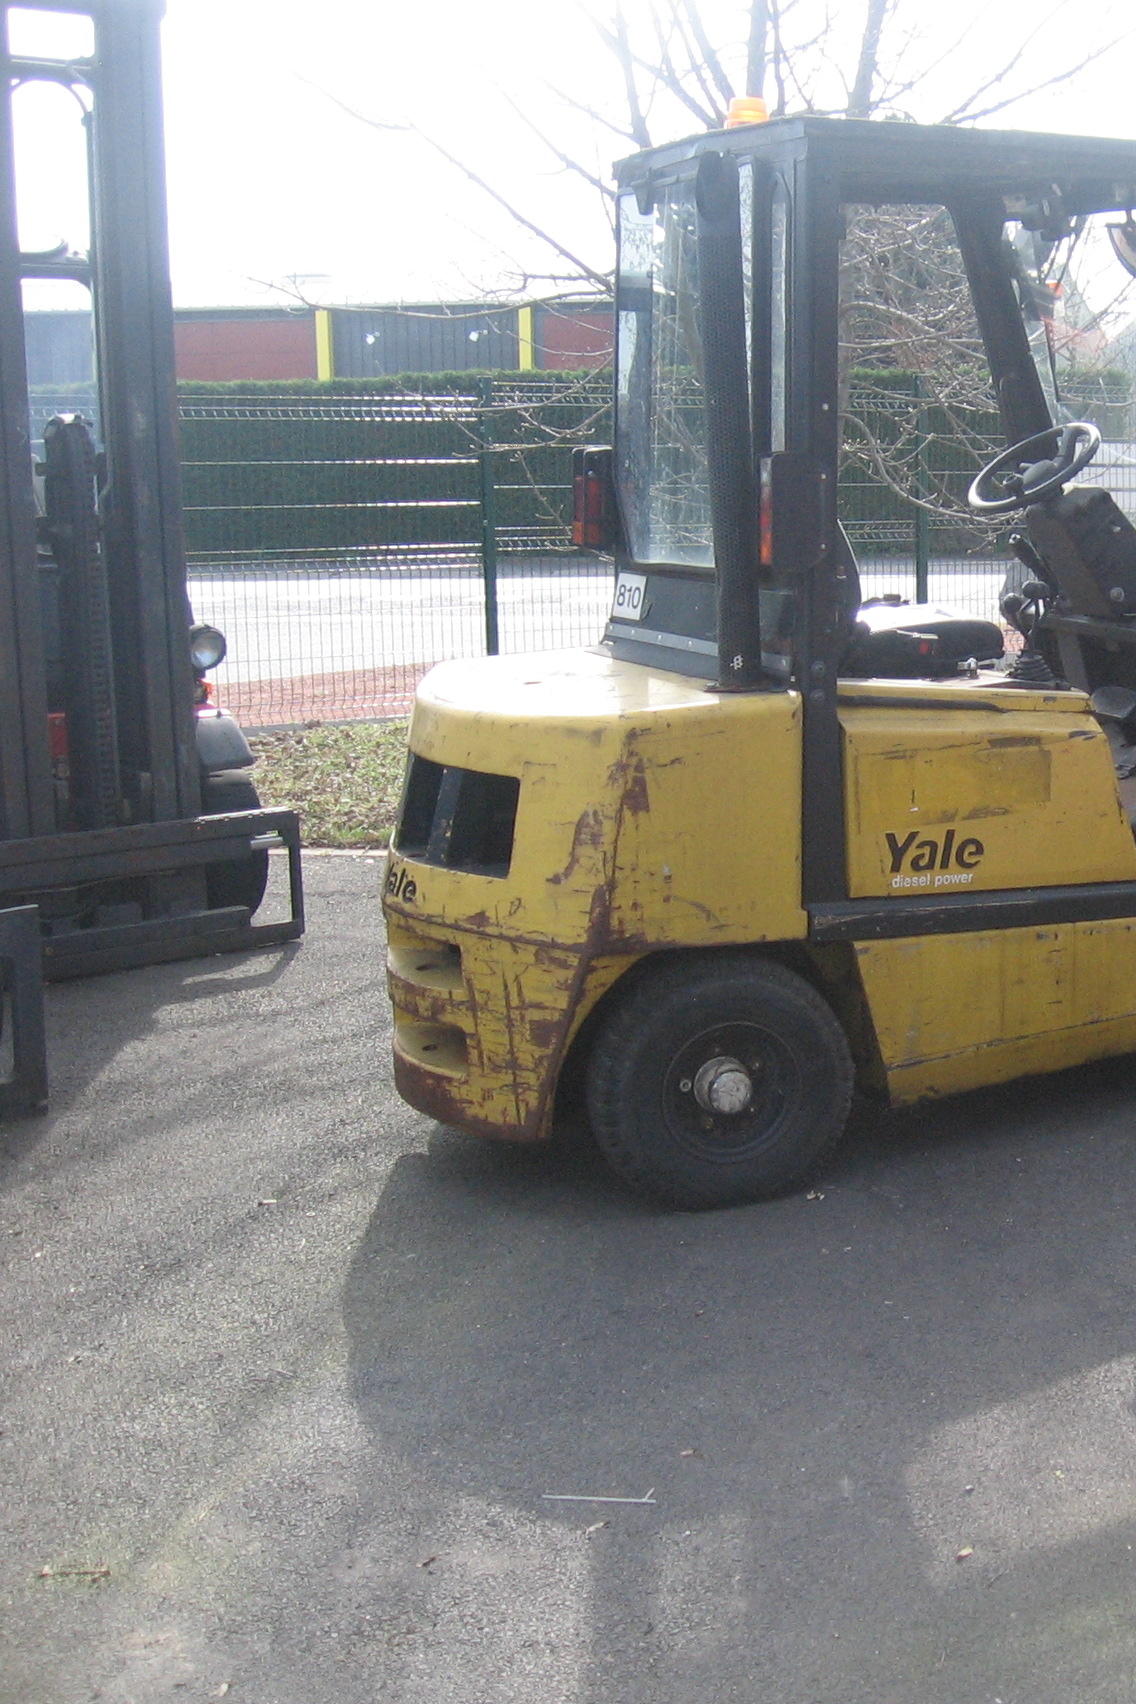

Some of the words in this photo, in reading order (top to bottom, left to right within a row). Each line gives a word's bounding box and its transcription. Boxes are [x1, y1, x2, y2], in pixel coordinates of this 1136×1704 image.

[616, 584, 642, 609] 810
[885, 829, 985, 873] Yale
[891, 873, 931, 888] diesel
[934, 872, 974, 888] power
